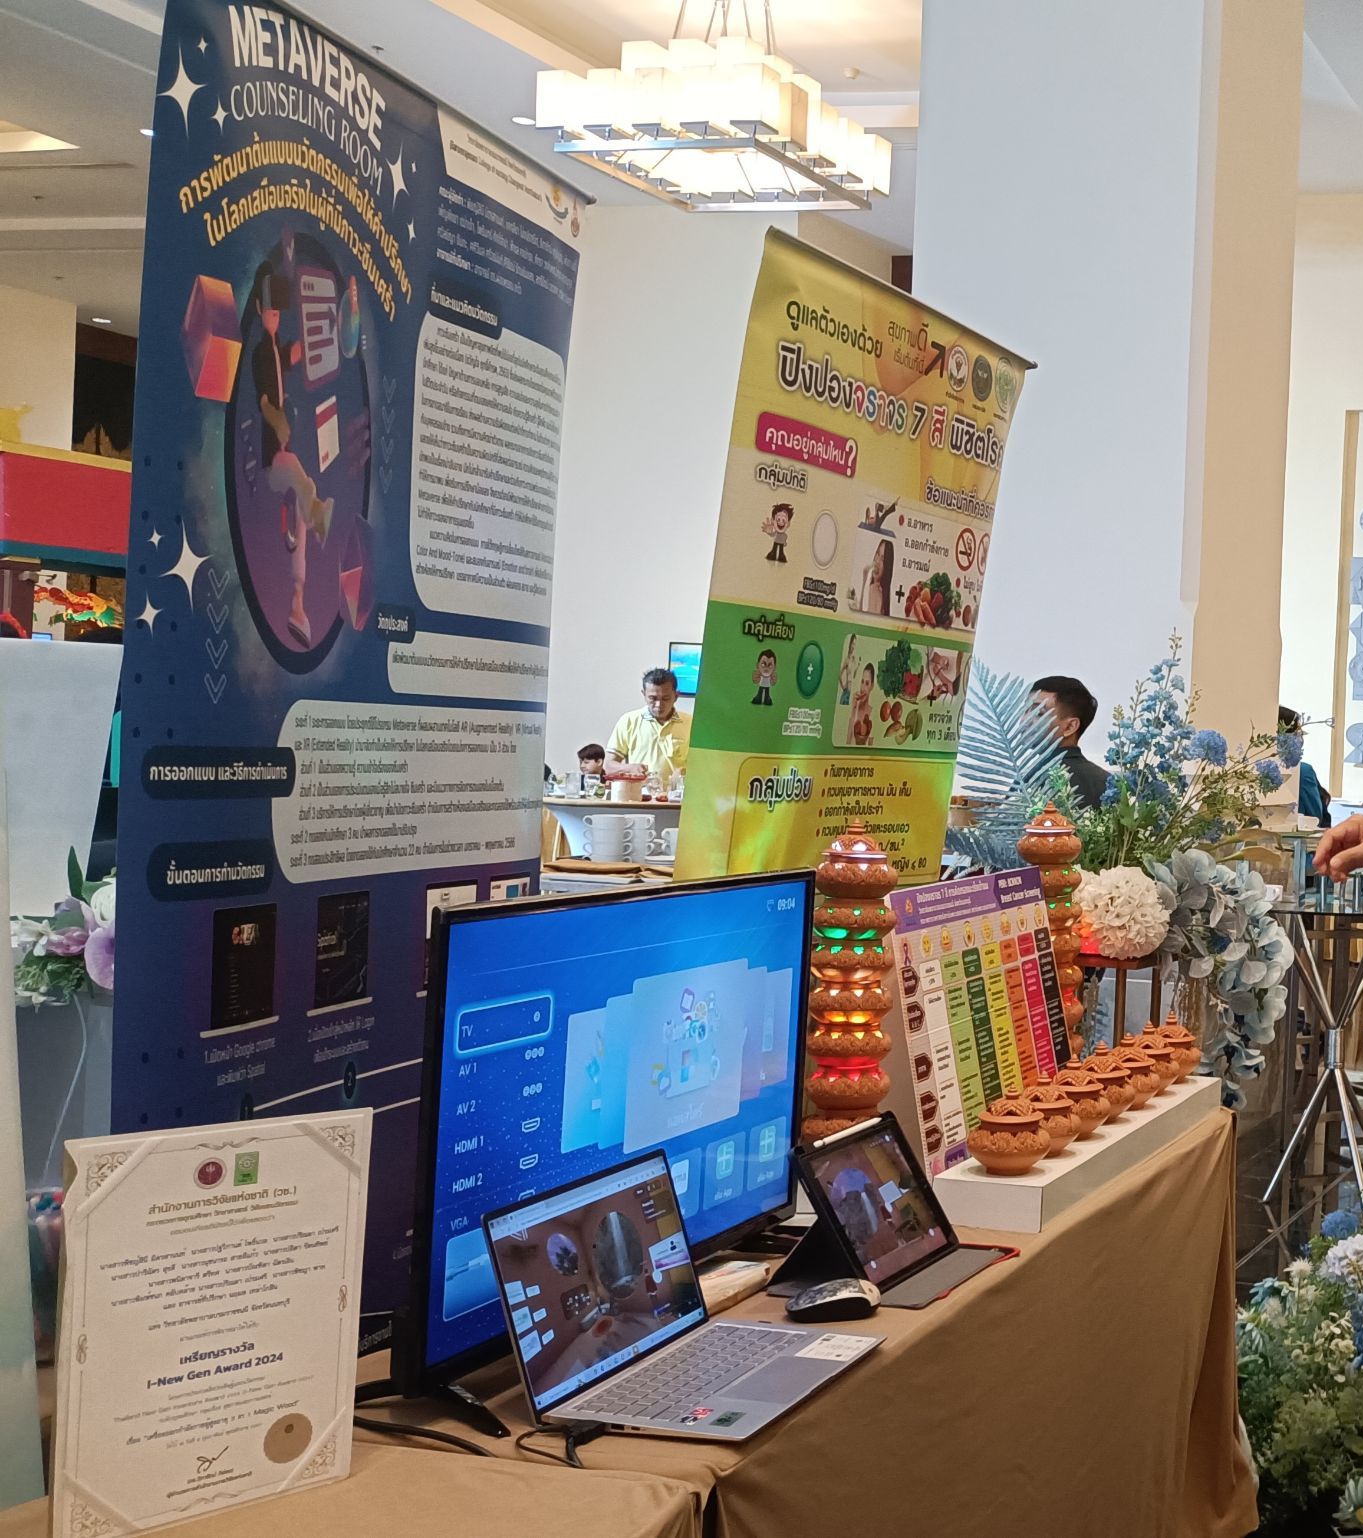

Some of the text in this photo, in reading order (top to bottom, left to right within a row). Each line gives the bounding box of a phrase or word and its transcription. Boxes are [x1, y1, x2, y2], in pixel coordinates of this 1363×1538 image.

[229, 5, 386, 151] METAVERSE
[230, 80, 383, 196] COUNSELING ROOM
[179, 132, 412, 304] การพัฒนาต้นแบบนวัตกรรมเพื่อให้คำปรึกษา
[786, 300, 882, 358] ดูแลตัวเองด้วย
[779, 341, 907, 433] ปิงปองจราจร
[911, 404, 927, 438] 7
[931, 406, 947, 448] สี
[765, 424, 857, 477] คุณอยู่กลุ่มไหน?
[758, 464, 806, 490] กลุ่มปกติ
[745, 614, 795, 641] กลุ่มเสี่ยง
[938, 730, 943, 741] 3
[149, 761, 288, 781] การออกแบบ และวิธีการดำเนินการ
[748, 766, 812, 811] กลุ่มป่วย
[166, 859, 265, 885] ขั้นตอนการทำนวัตกรรม
[917, 857, 927, 868] 80
[777, 898, 796, 911] 09:04
[461, 1024, 473, 1038] TV
[458, 1064, 471, 1078] AV
[456, 1101, 476, 1117] AV 2
[454, 1138, 478, 1156] HDMI
[452, 1173, 483, 1194] HDMI 2
[148, 1185, 297, 1215] สำนักงานการวิจัยแห่งชาติ (วช.)
[450, 1216, 468, 1231] VGA
[180, 1341, 255, 1366] เหรียญรางวัล
[147, 1372, 184, 1390] I-New
[187, 1368, 211, 1381] Gen
[214, 1359, 252, 1376] Award
[254, 1352, 284, 1367] 2024
